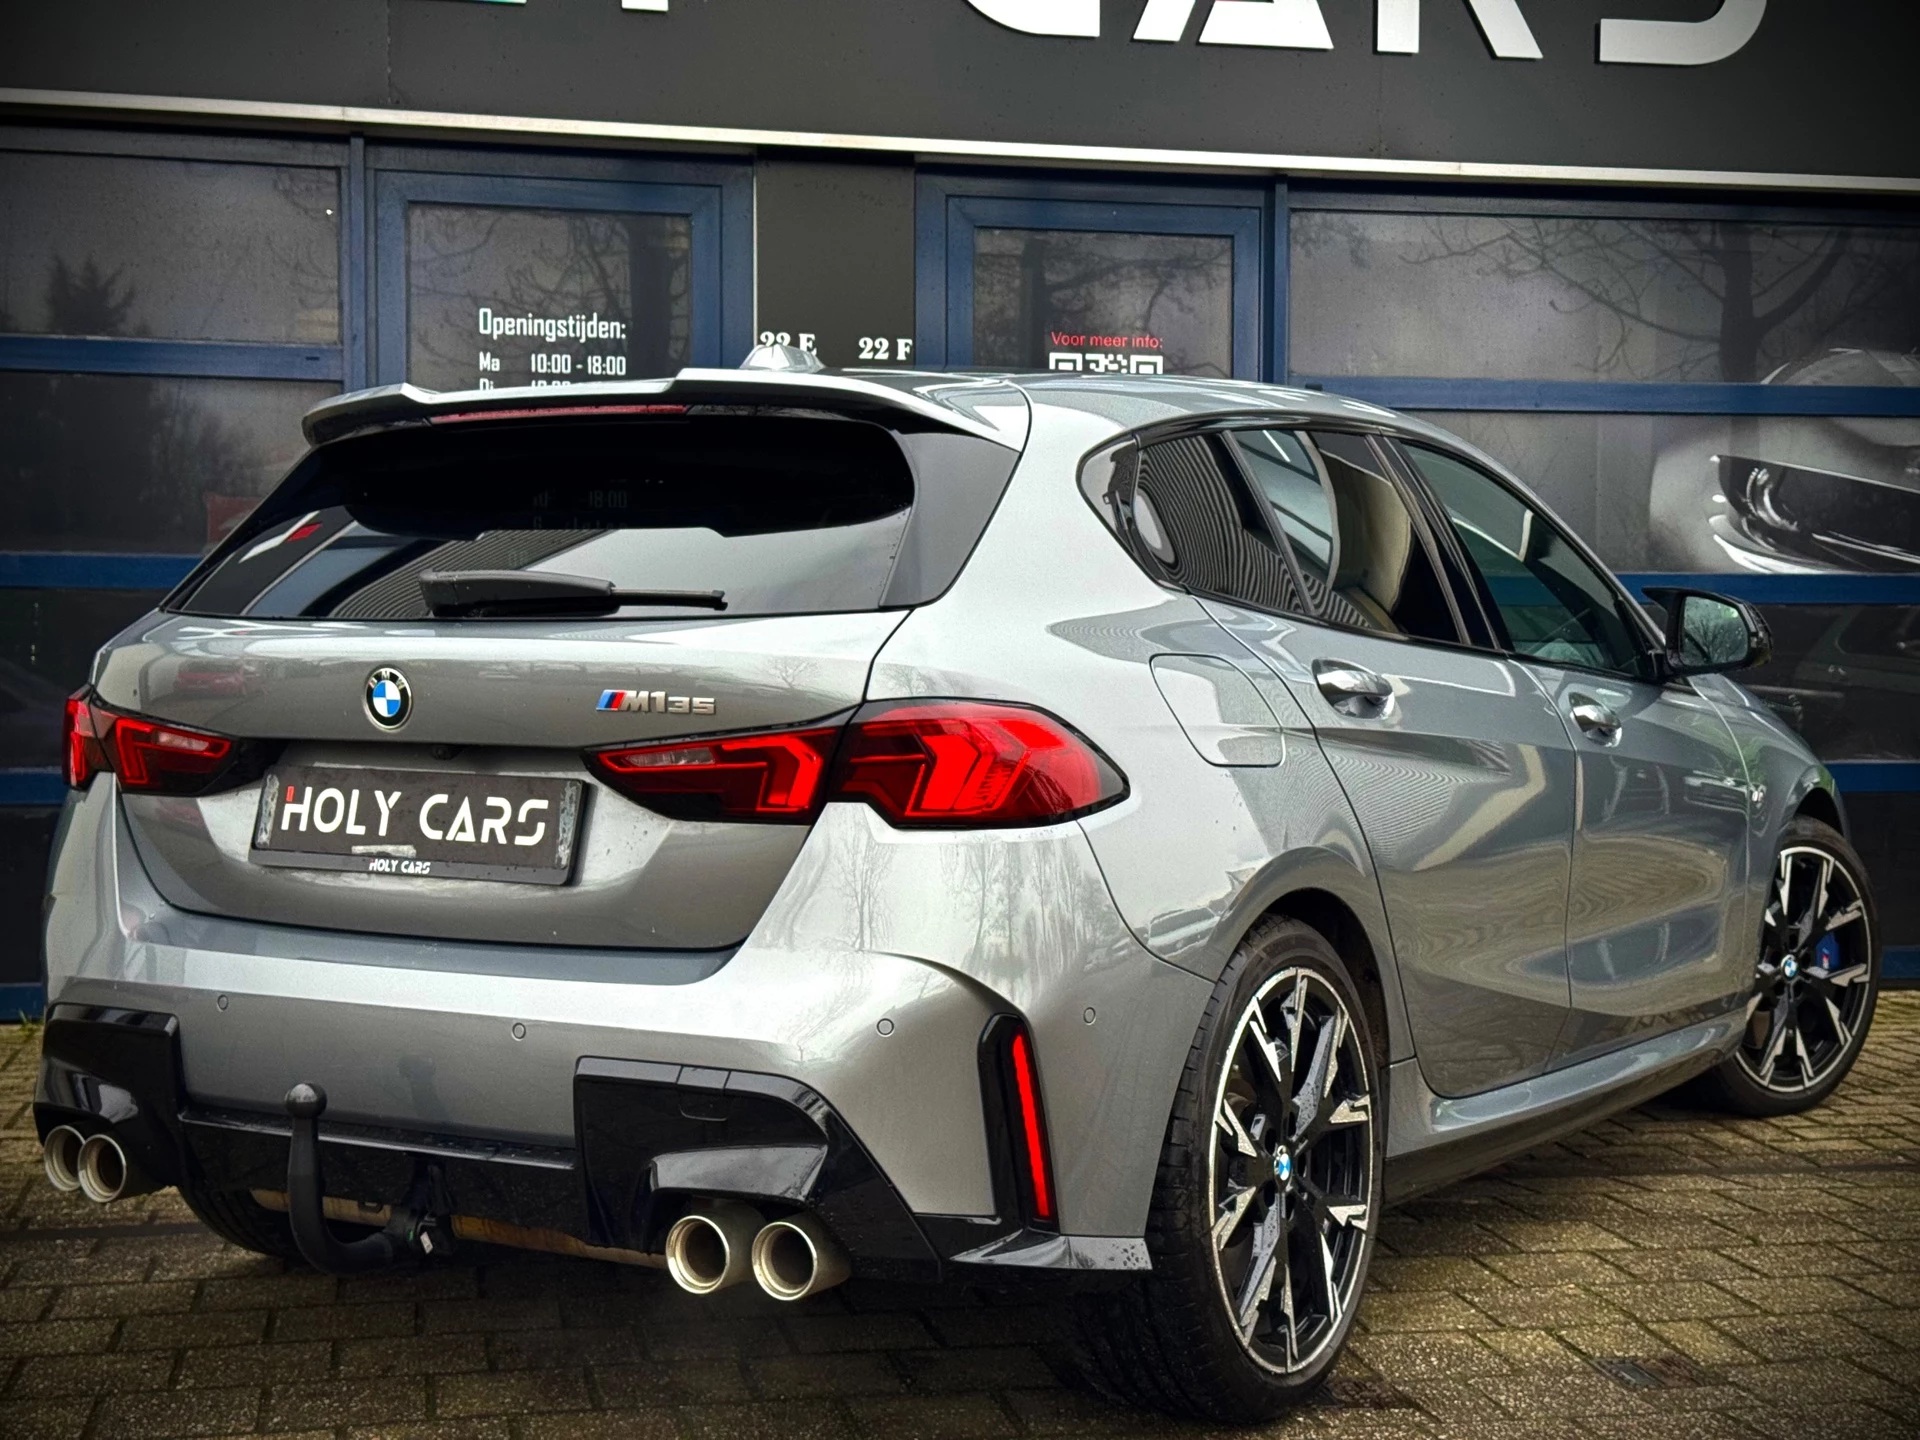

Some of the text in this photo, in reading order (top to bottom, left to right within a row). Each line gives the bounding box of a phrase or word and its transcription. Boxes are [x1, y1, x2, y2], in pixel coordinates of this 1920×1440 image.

[479, 308, 627, 343] Openingstijden:
[858, 337, 913, 361] 22 F
[1051, 331, 1163, 349] Voor meer info:
[479, 351, 501, 372] Ma
[531, 353, 572, 374] 10:00
[587, 355, 627, 376] 18:00
[619, 690, 715, 714] M135
[281, 786, 549, 846] HOLY CARS
[369, 858, 431, 875] HOLY CARS
